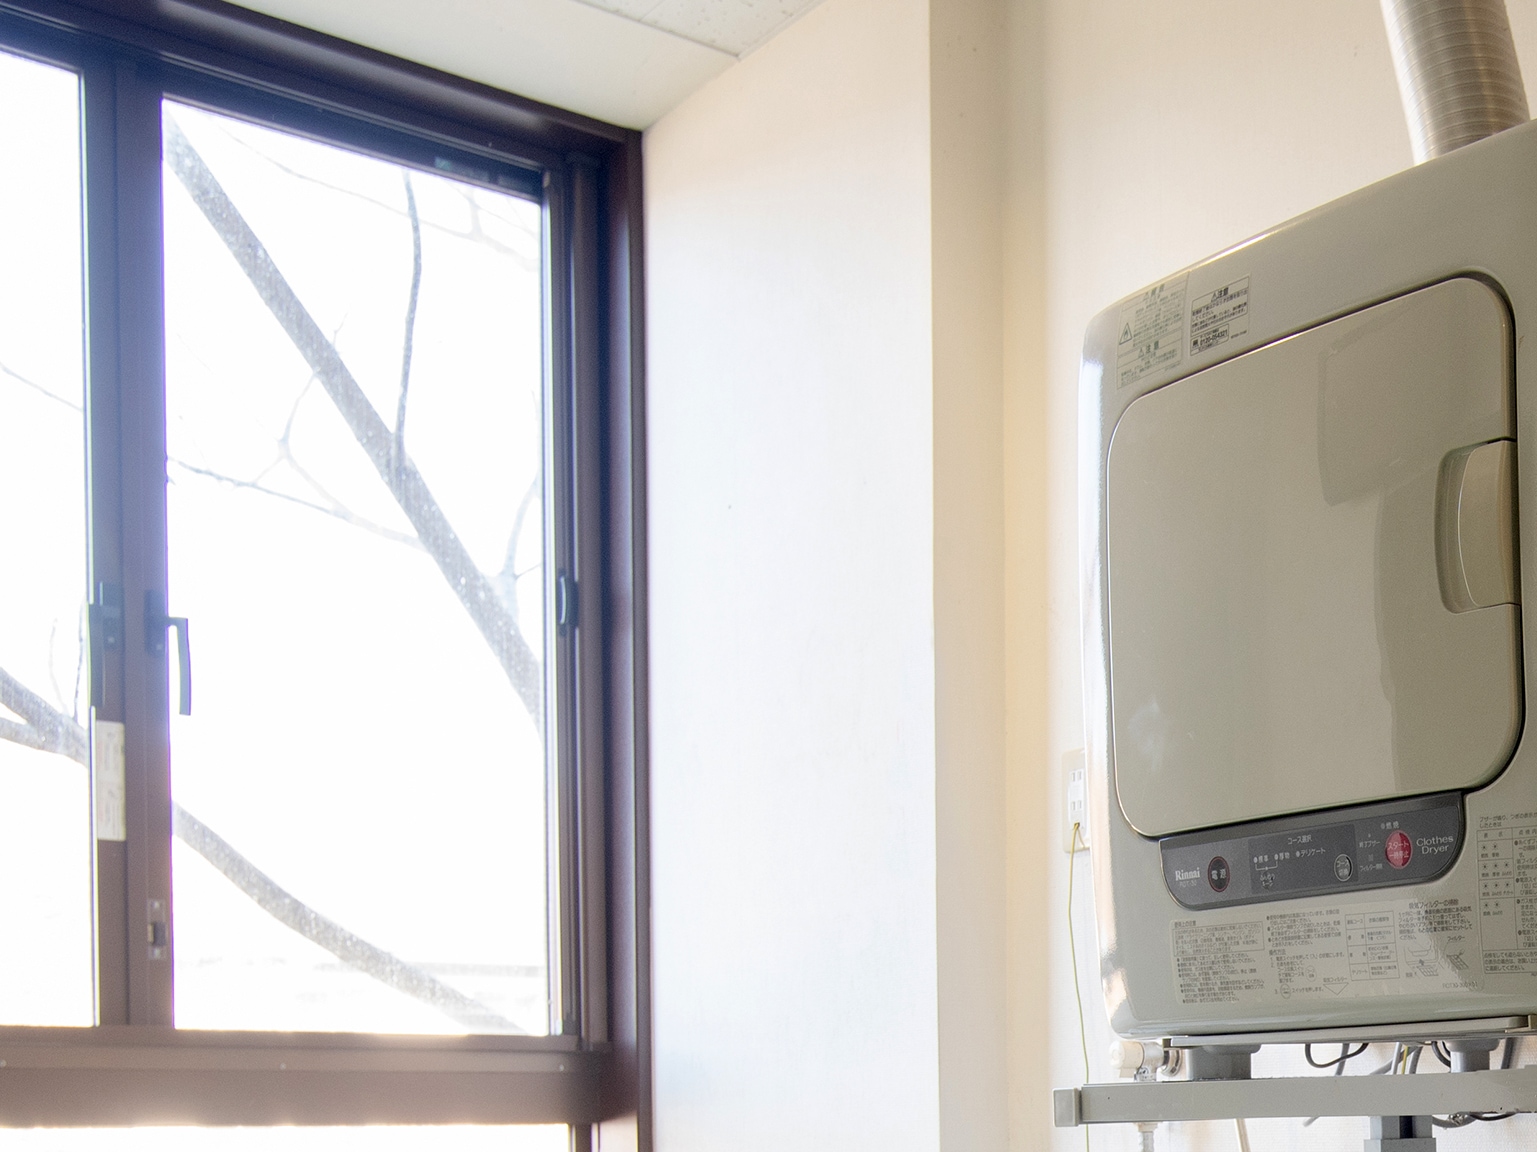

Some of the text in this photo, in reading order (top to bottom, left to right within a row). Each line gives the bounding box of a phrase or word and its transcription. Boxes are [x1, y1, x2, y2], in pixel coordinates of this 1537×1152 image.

[1288, 834, 1312, 845] コース選択
[1387, 840, 1409, 850] スタート
[1416, 835, 1454, 847] Clothes
[1301, 847, 1326, 858] デリケート
[1421, 844, 1450, 855] Dryer
[1175, 867, 1201, 881] Rinnai
[1211, 868, 1227, 881] 電源
